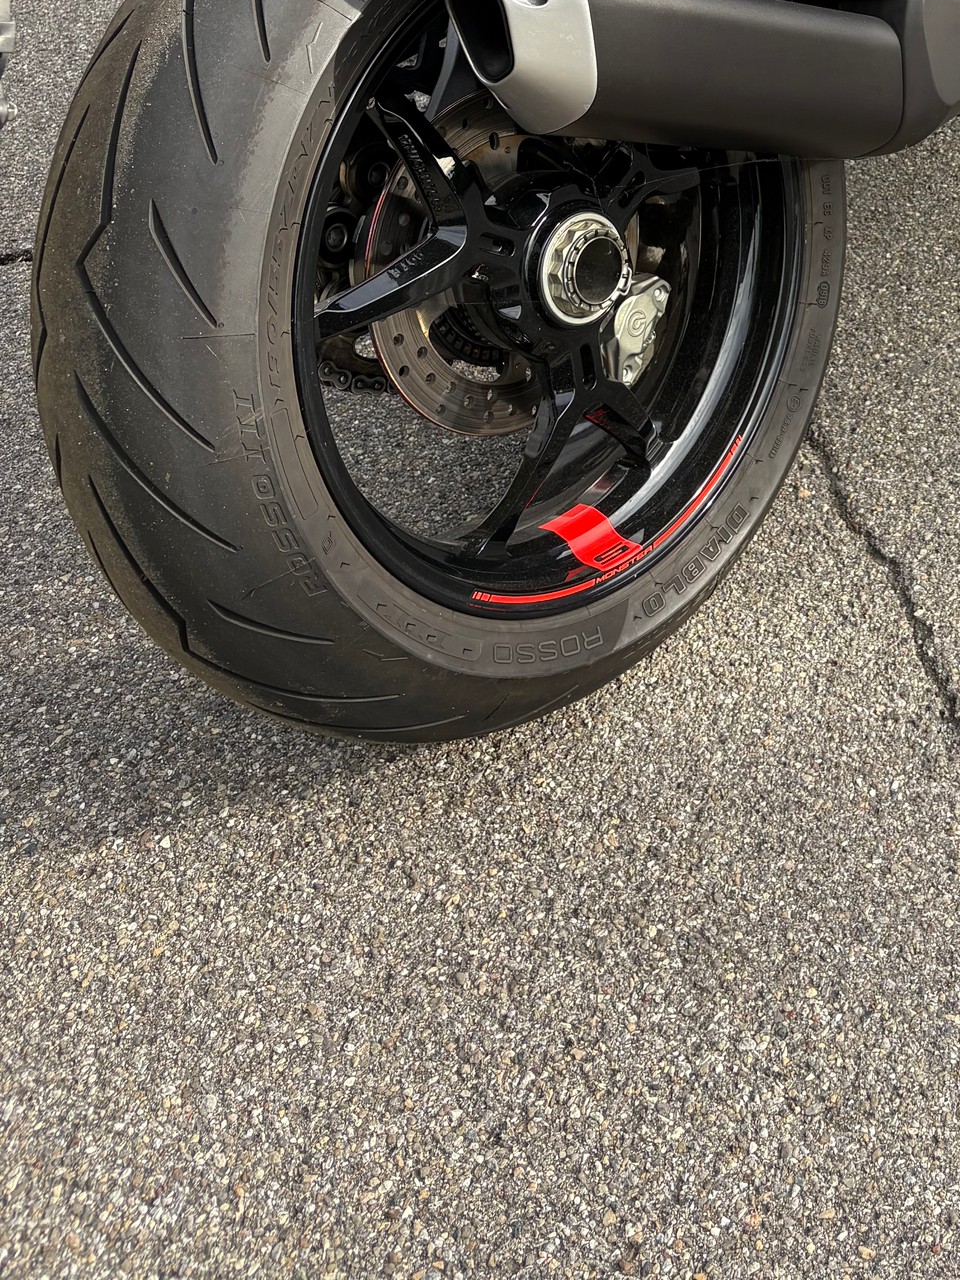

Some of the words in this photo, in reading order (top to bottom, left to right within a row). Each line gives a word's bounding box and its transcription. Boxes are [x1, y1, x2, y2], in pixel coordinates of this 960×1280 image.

[232, 388, 267, 464] III
[252, 474, 327, 597] ROSSO
[596, 546, 653, 583] MONSTER
[642, 503, 749, 617] DIABLO
[493, 626, 604, 664] ROSSO
